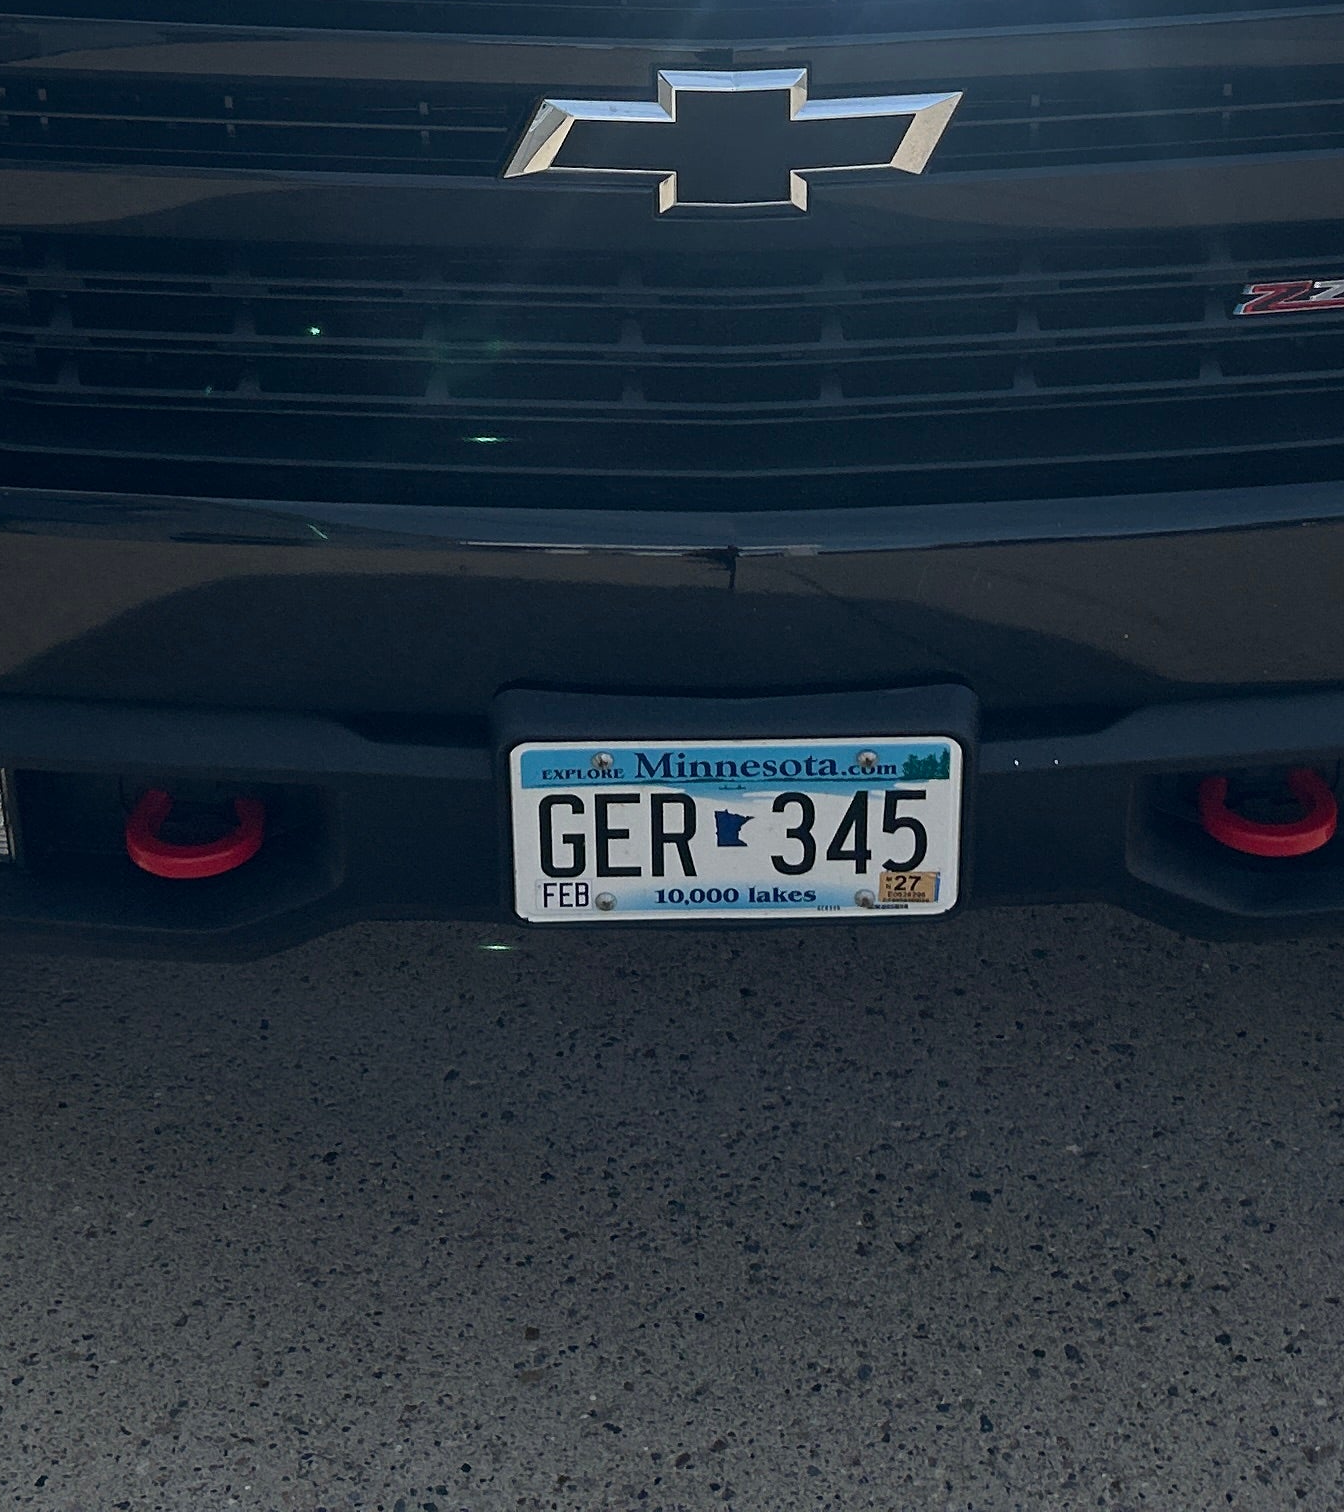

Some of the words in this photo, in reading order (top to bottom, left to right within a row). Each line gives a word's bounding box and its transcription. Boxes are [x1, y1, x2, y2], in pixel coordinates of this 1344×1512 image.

[542, 767, 625, 780] EXPLORE
[635, 752, 897, 779] Minnesota.com
[538, 793, 698, 878] GER
[770, 789, 929, 876] 345
[542, 882, 589, 908] FEB
[654, 887, 739, 906] 10,000
[747, 886, 817, 903] lakes
[893, 875, 922, 891] 27
